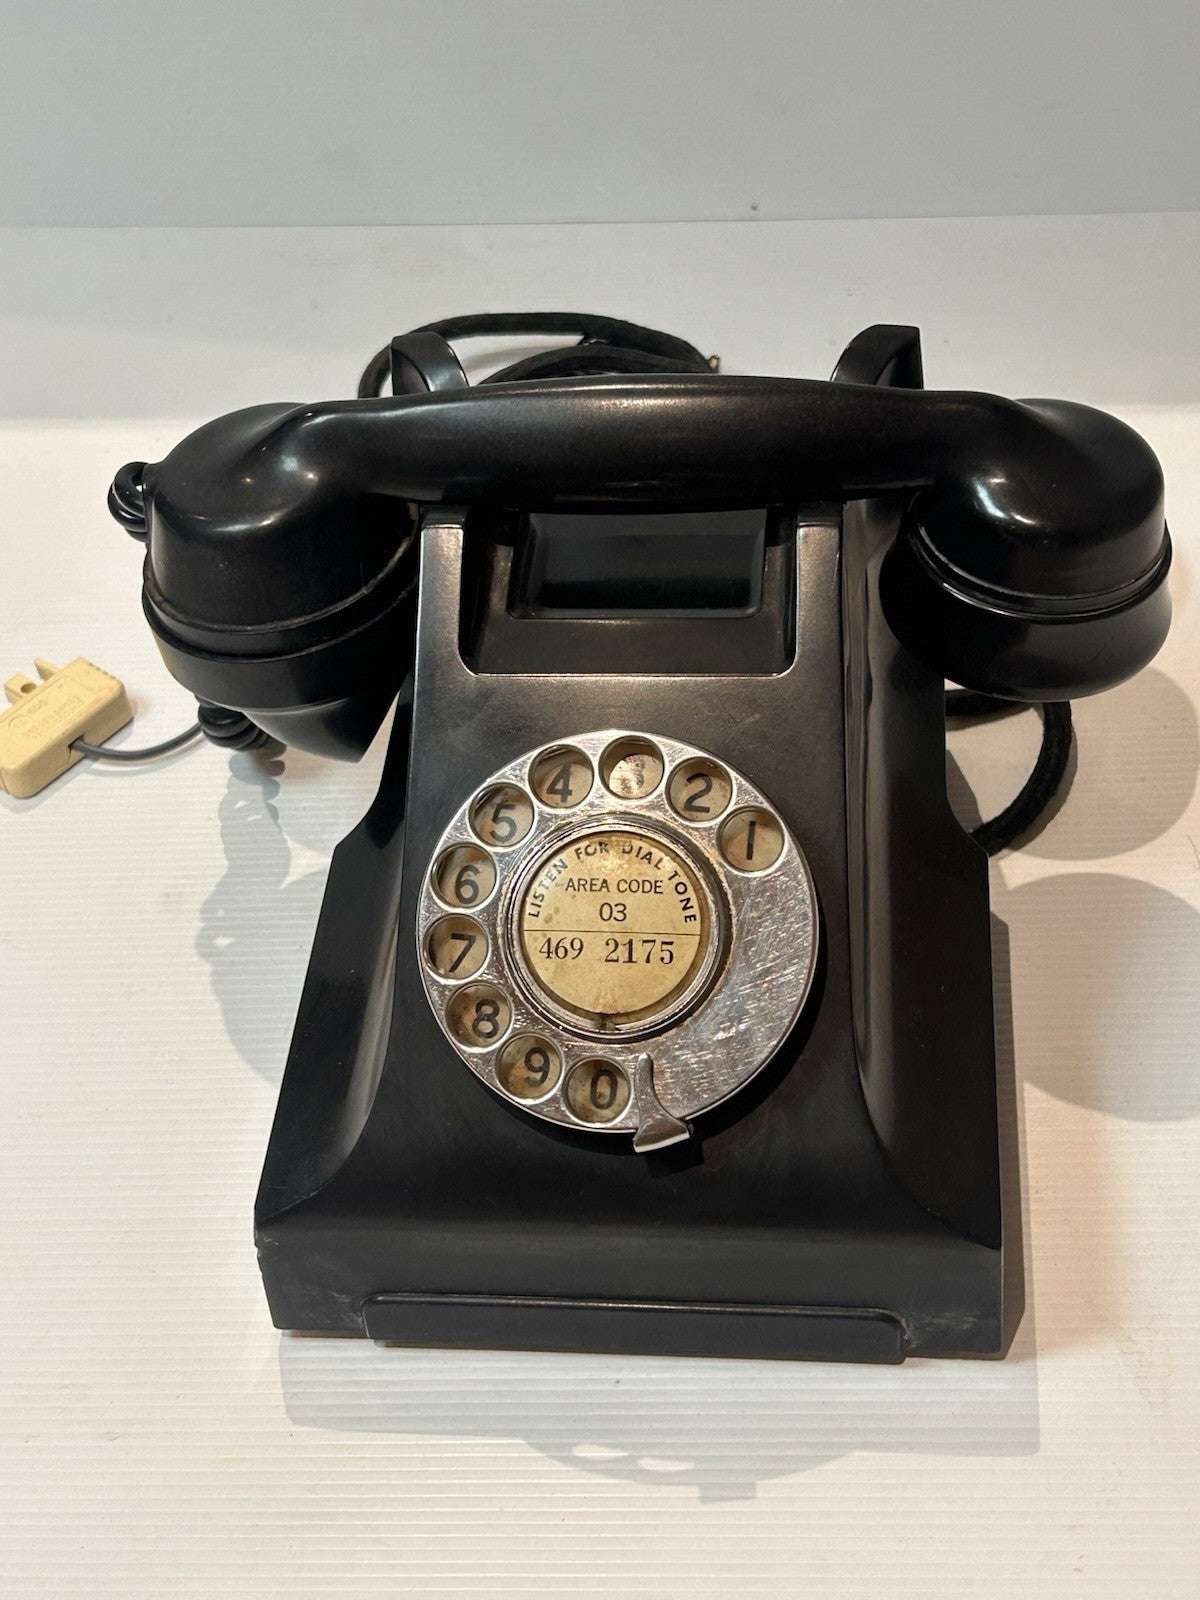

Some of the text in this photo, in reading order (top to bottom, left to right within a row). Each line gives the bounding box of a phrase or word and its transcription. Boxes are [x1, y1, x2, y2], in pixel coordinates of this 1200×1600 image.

[547, 764, 573, 803] 4
[684, 772, 713, 814] 2
[489, 804, 518, 843] 5
[746, 820, 756, 861] 1
[455, 865, 480, 902] 6
[528, 841, 697, 923] LISTEN FOR DIAL TONE
[565, 877, 664, 894] AREA CODE
[599, 902, 627, 922] 03
[449, 933, 477, 973] 7
[539, 937, 675, 965] 469 2175
[473, 999, 500, 1039] 8
[524, 1047, 551, 1086] 9
[590, 1069, 618, 1110] 0
